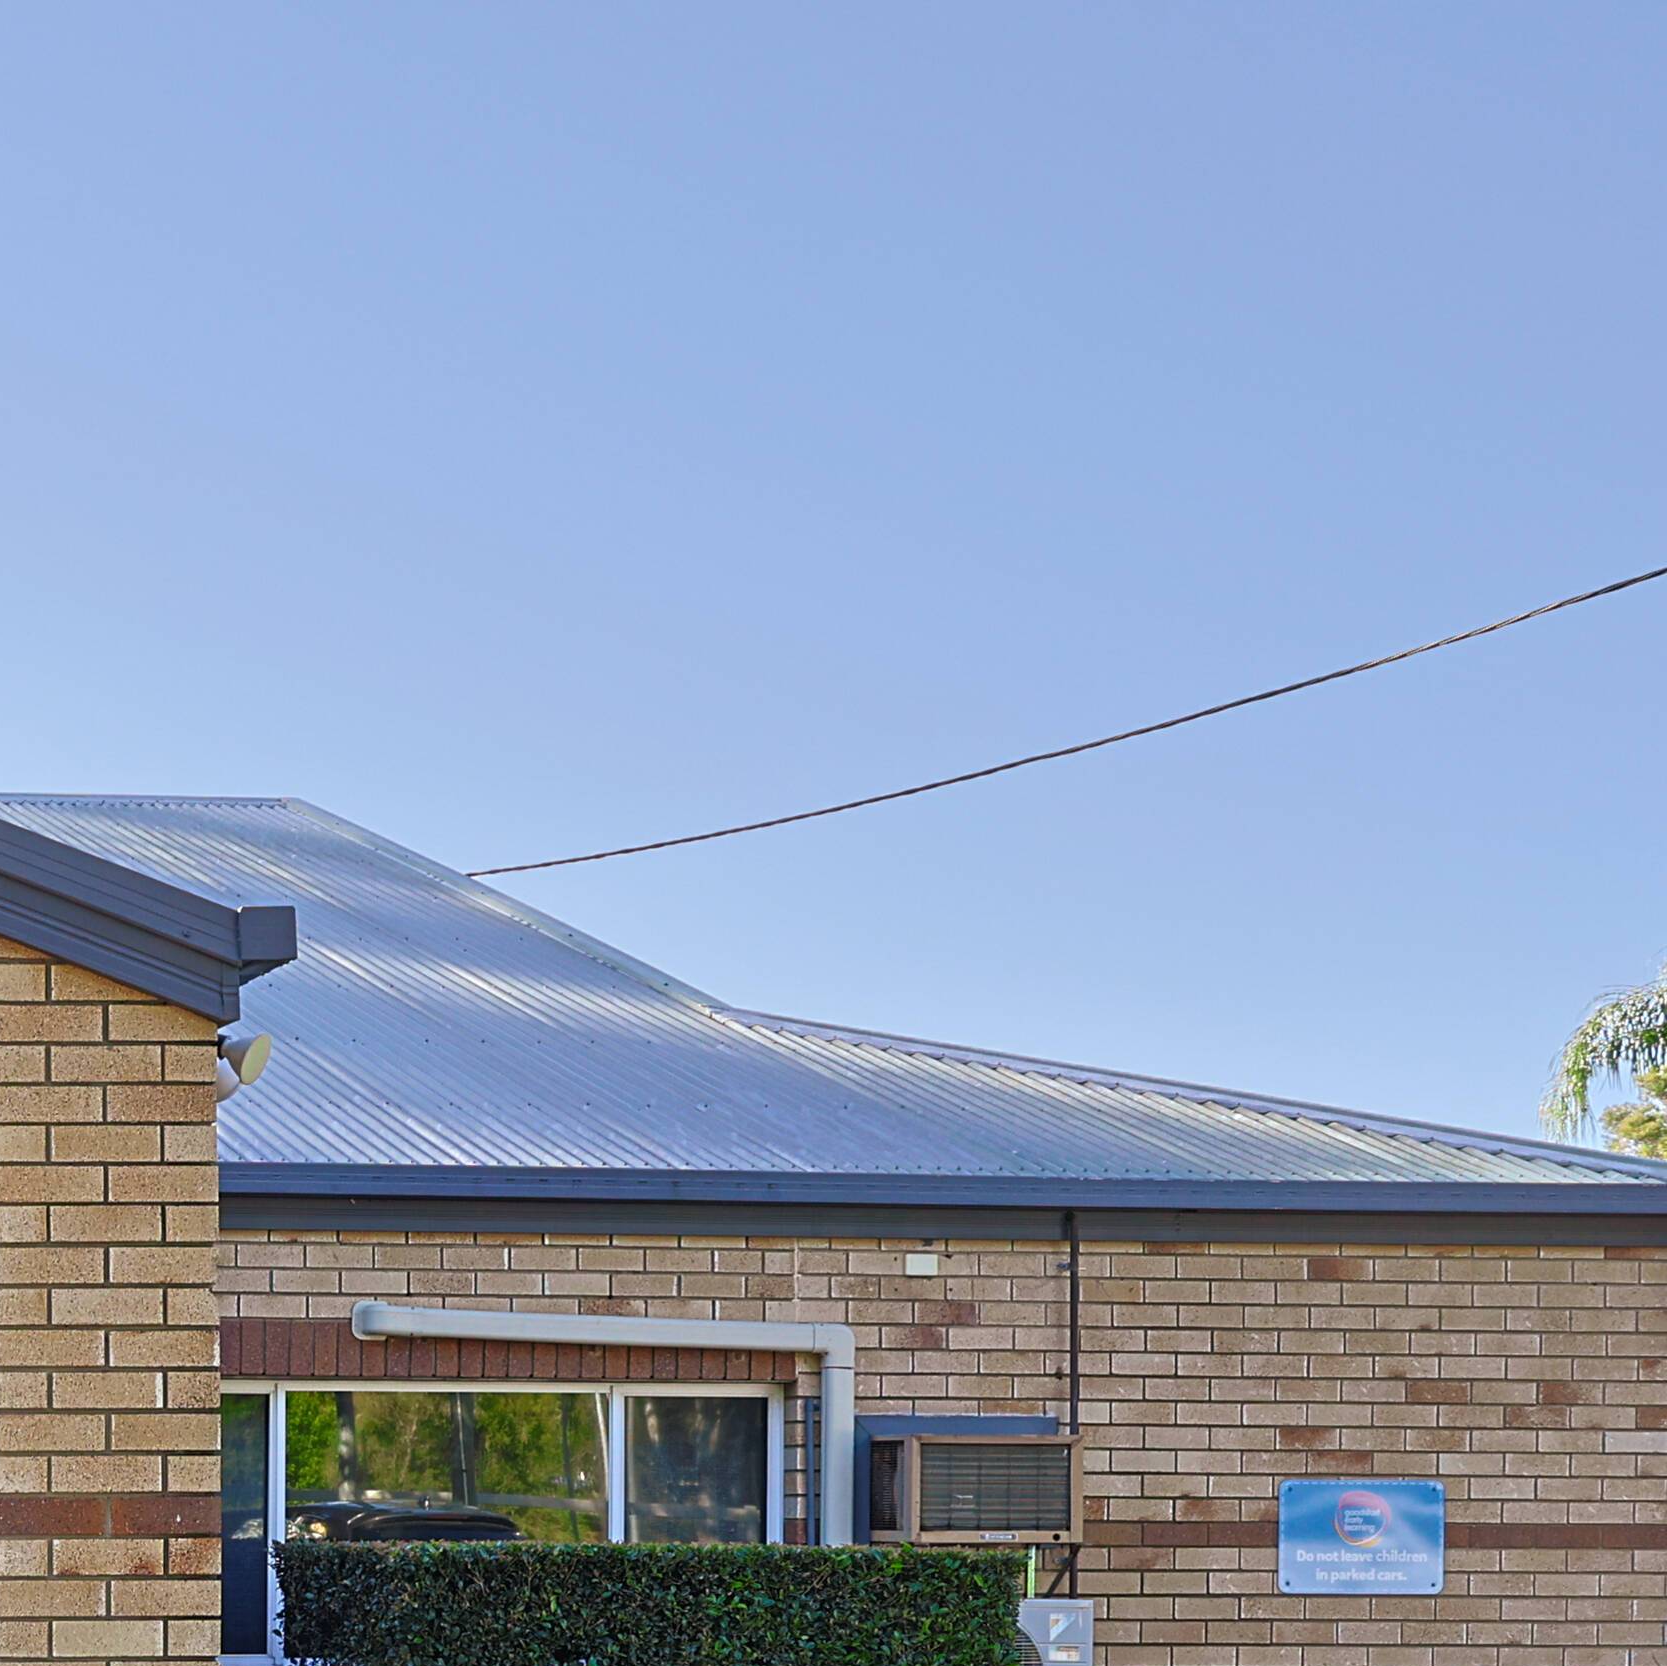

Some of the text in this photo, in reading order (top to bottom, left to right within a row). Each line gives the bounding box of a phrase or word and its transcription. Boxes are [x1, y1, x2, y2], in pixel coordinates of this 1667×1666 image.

[1296, 1550, 1428, 1562] Do not leave children
[1316, 1568, 1407, 1583] in parked cars.
